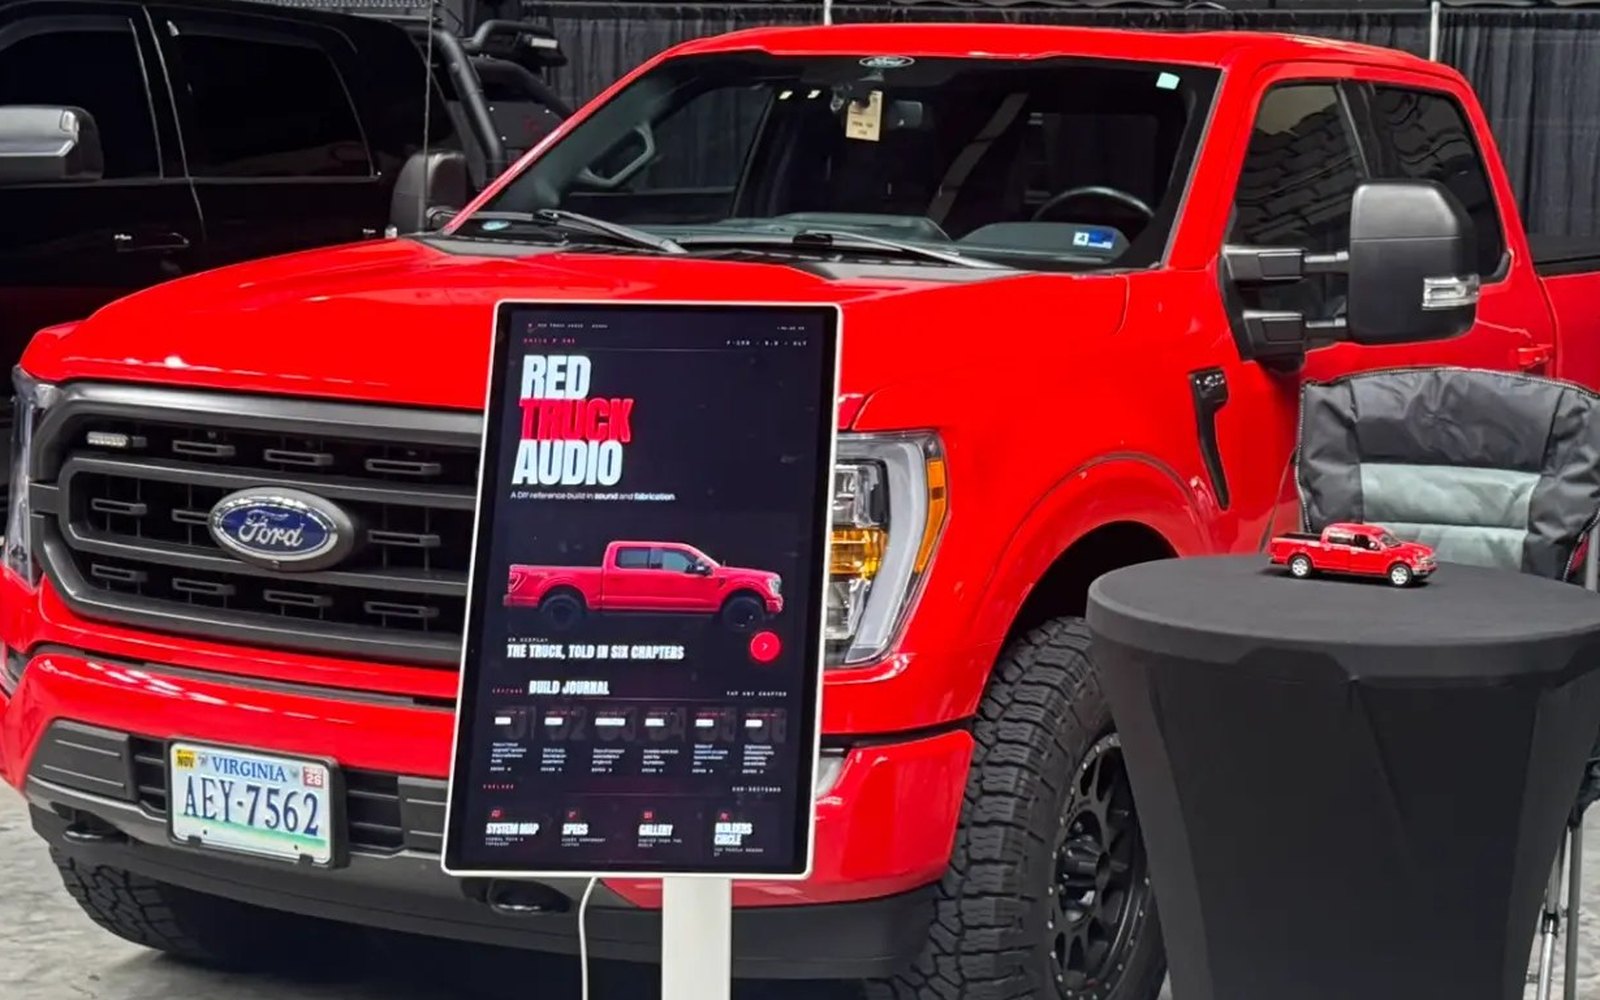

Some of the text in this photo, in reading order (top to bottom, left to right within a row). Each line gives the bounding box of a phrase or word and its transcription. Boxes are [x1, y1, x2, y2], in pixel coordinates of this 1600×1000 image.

[521, 355, 592, 399] RED
[519, 398, 634, 442] TRUCK
[512, 440, 624, 486] AUDIO
[510, 490, 517, 499] A
[594, 492, 619, 500] sound
[619, 492, 634, 500] and
[238, 509, 306, 548] Ford
[507, 644, 685, 660] THE TRUCK, TOLD IN SIX CHAPTERS
[528, 680, 560, 694] BUILD
[562, 681, 610, 695] JOURNAL
[212, 756, 288, 783] VIRGINIA
[183, 775, 319, 837] AEY-7562
[486, 823, 519, 835] SYSTEM
[562, 823, 588, 835] SPECS
